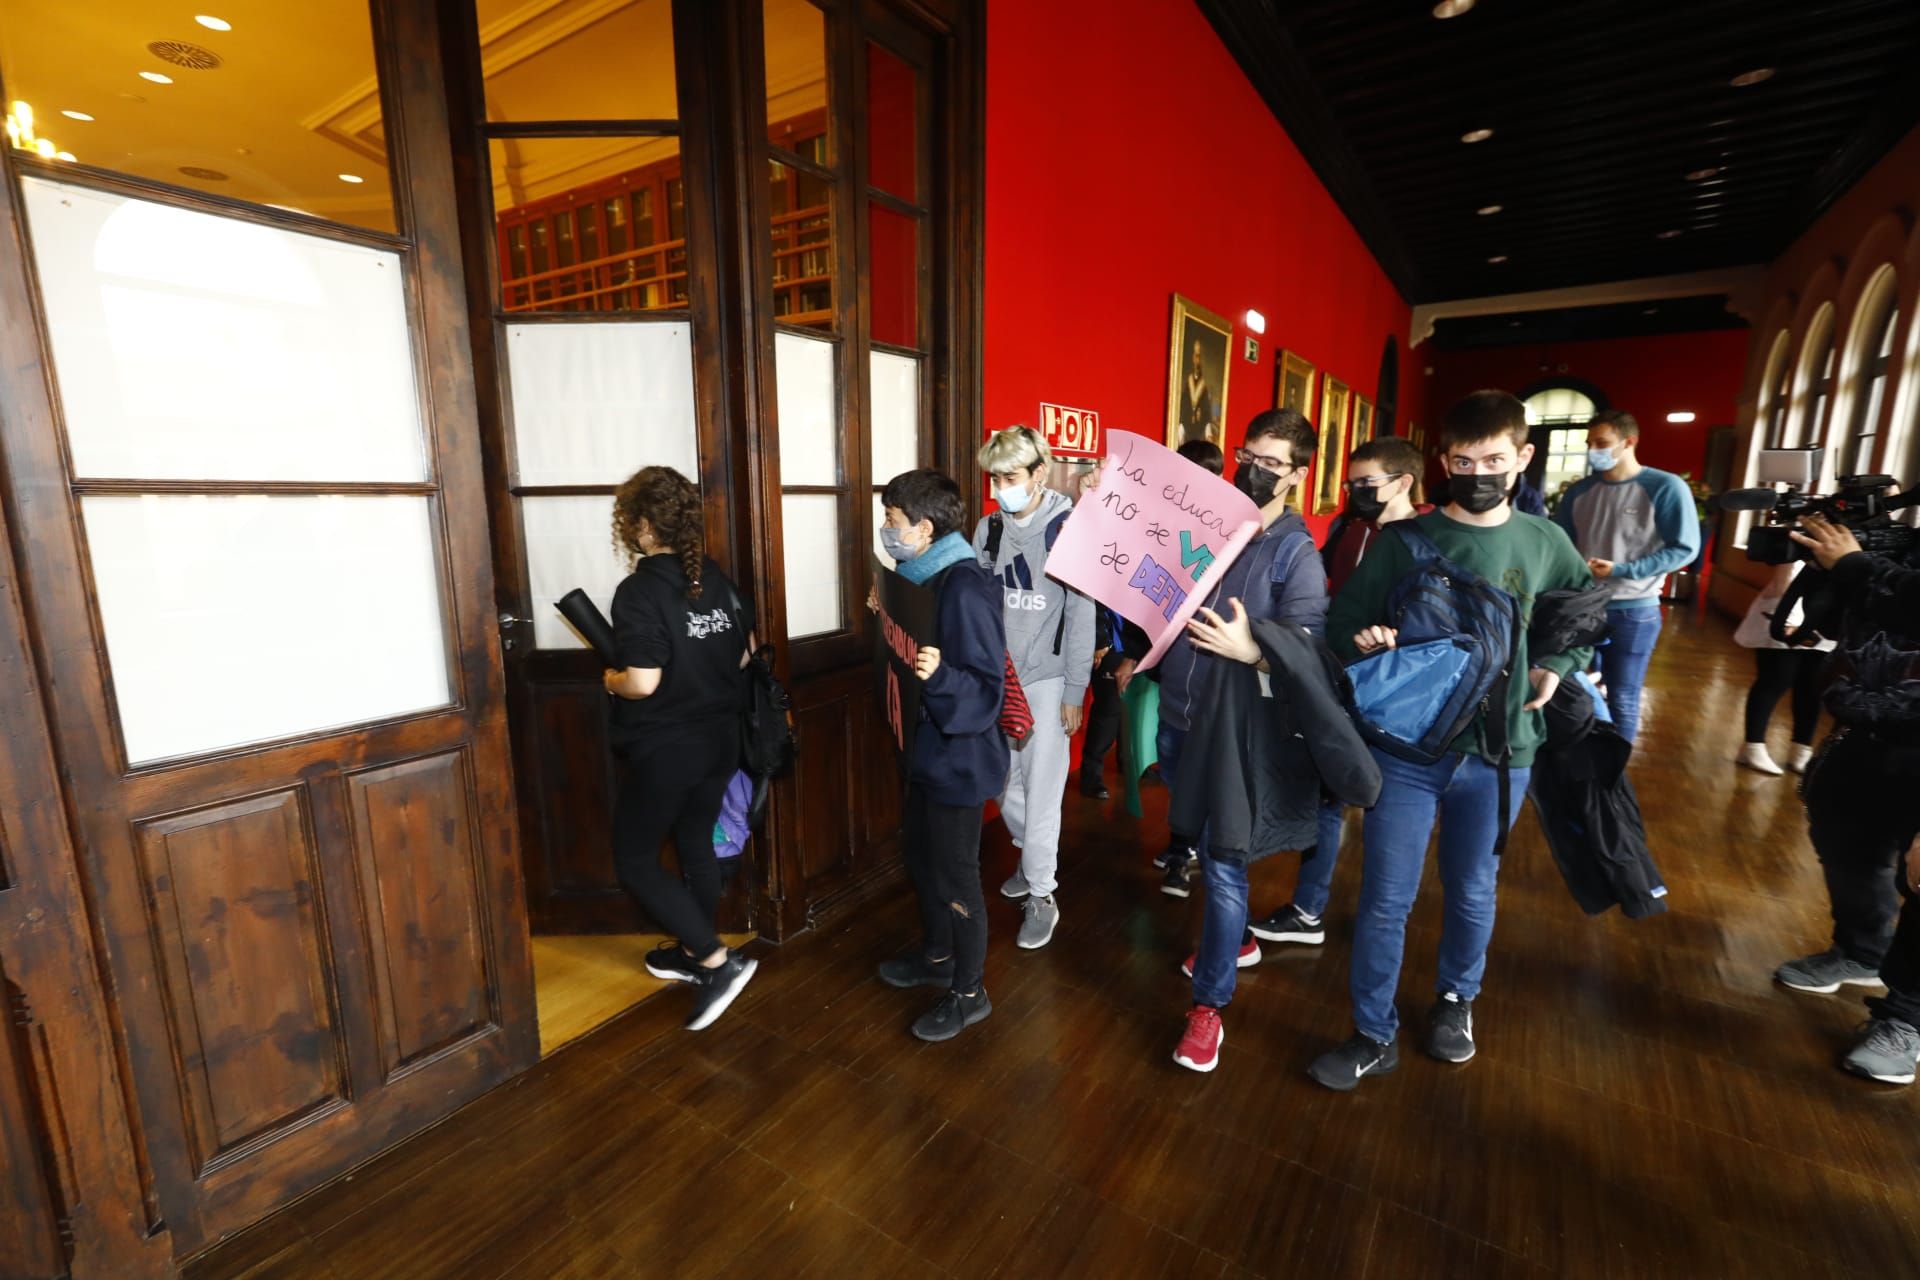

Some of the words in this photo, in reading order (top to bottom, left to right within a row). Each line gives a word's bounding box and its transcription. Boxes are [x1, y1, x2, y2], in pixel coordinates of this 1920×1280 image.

[1117, 440, 1147, 486] La
[1102, 491, 1140, 521] no
[1145, 523, 1170, 547] se
[1100, 542, 1130, 575] se
